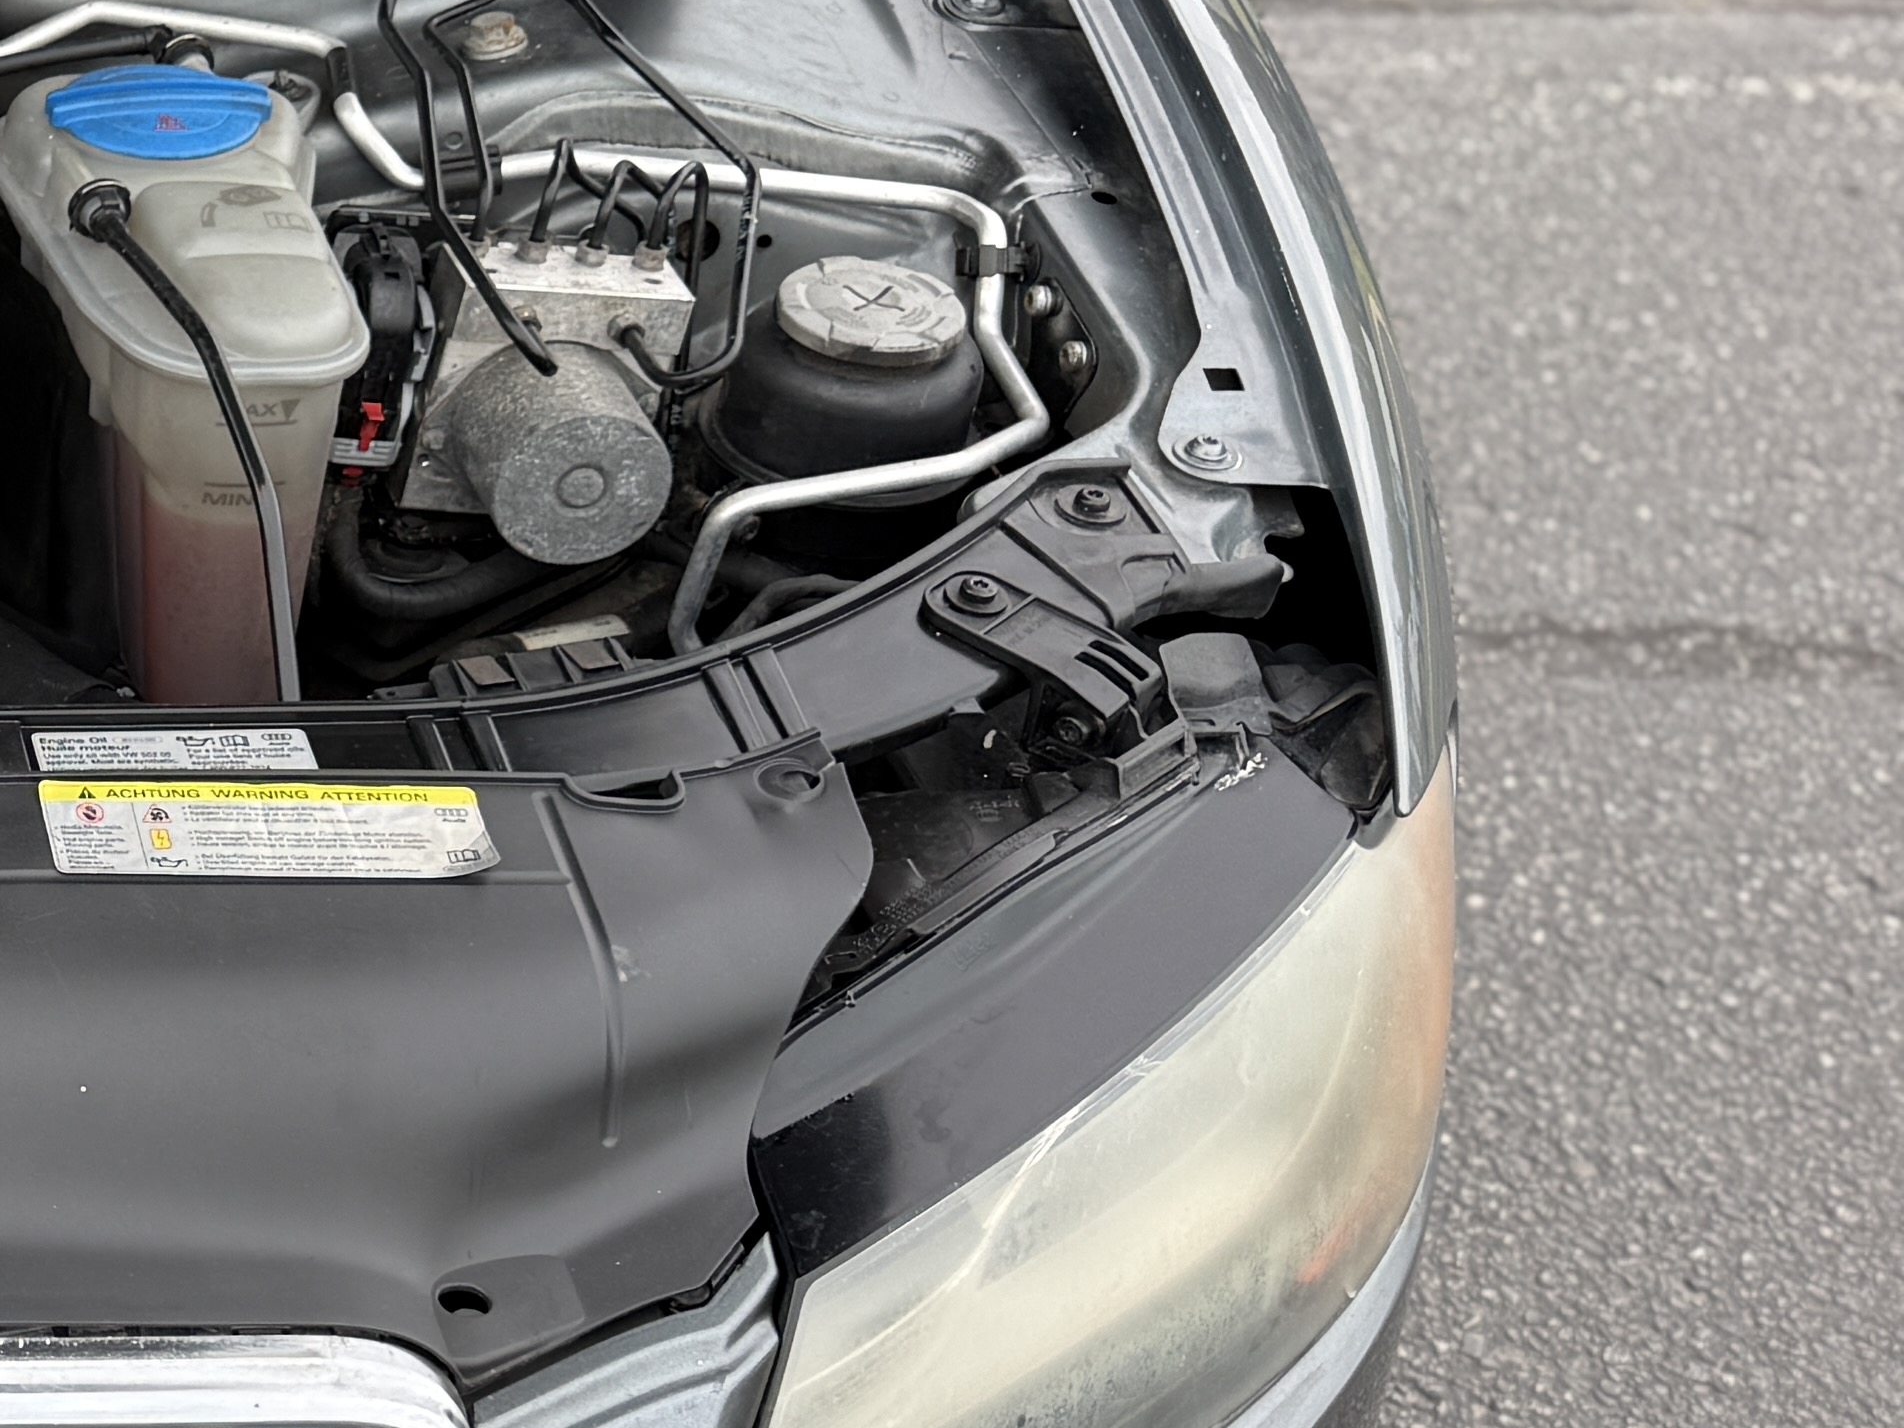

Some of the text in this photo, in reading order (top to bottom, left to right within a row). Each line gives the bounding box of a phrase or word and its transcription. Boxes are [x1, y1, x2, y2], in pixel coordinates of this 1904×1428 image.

[202, 493, 253, 507] MIN
[39, 737, 85, 745] Engine
[89, 736, 108, 745] Oil
[106, 788, 429, 802] ACHTUNG WARNING ATTENTION
